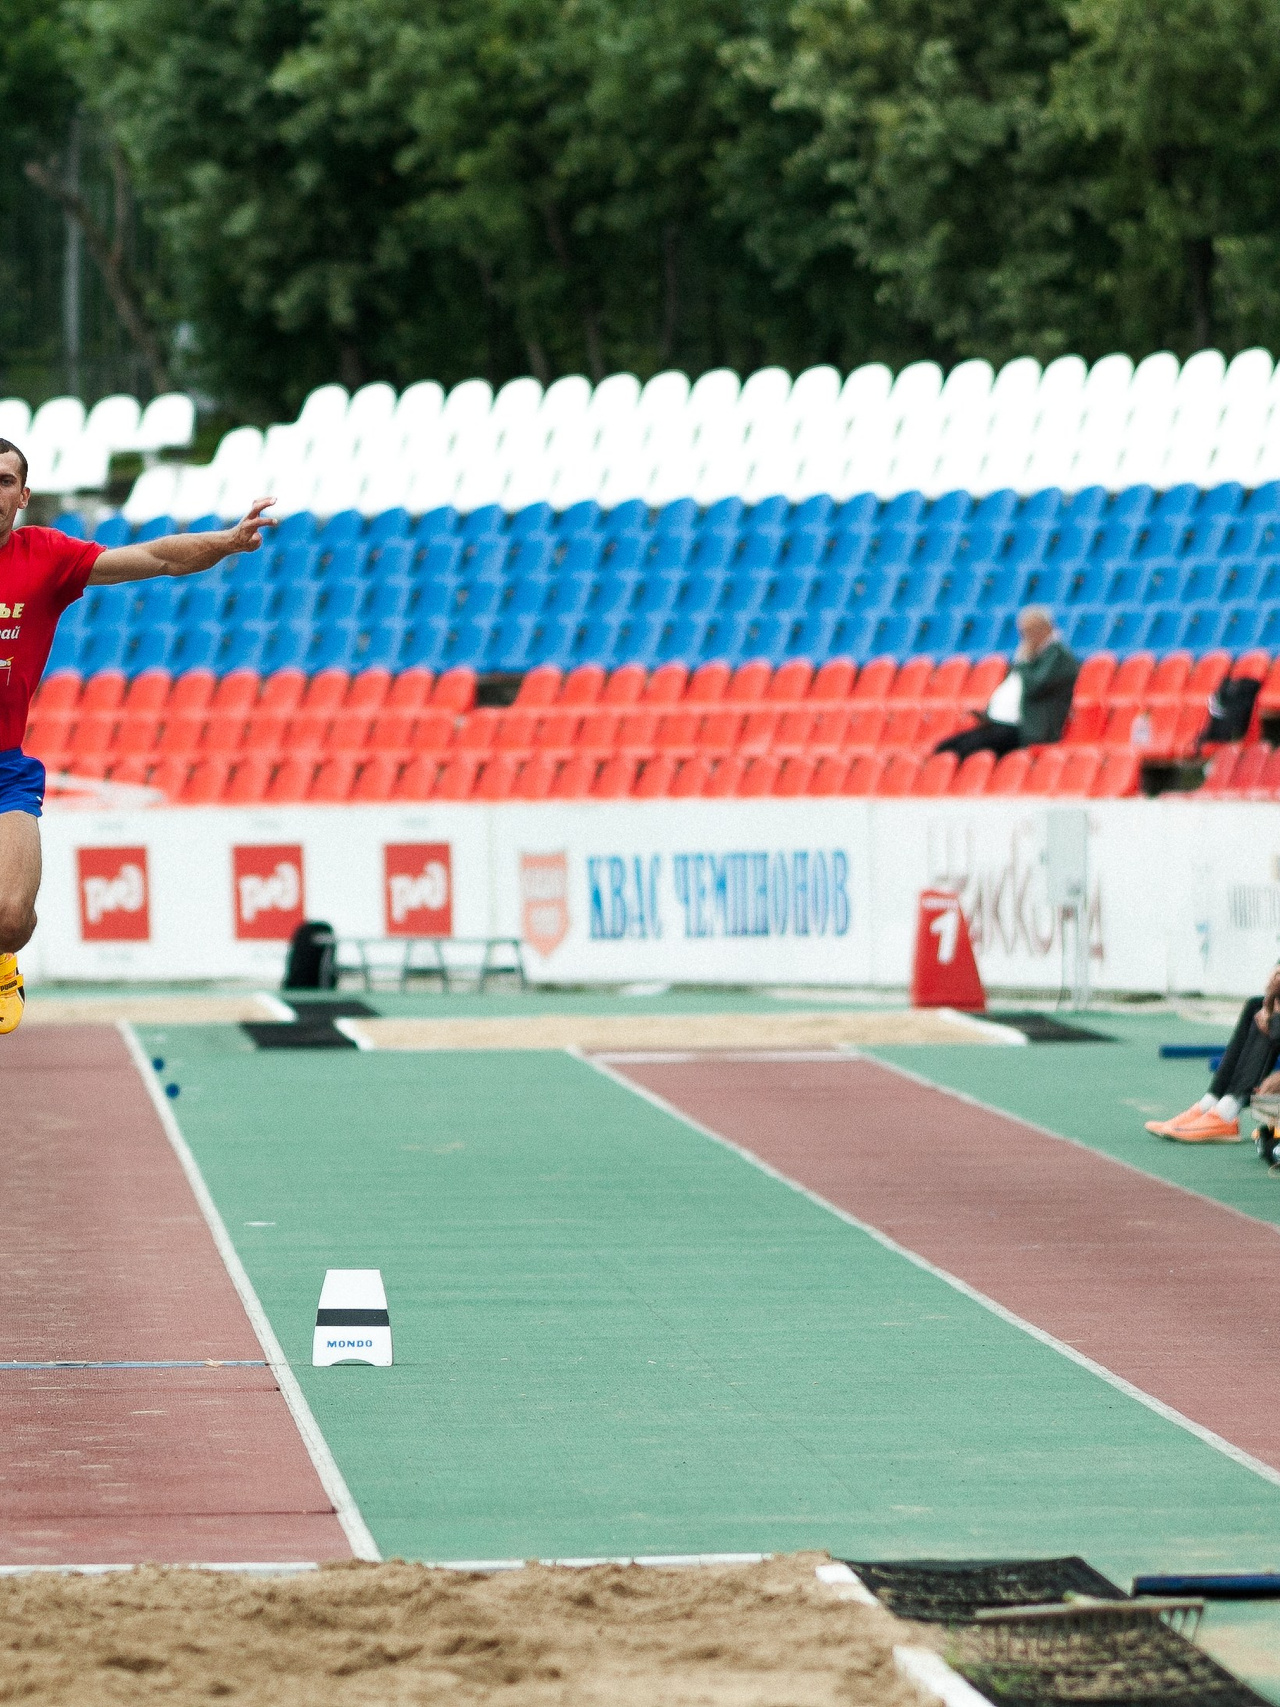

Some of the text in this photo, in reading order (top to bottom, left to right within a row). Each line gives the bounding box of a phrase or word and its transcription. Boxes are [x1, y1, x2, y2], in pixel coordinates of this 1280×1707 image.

[586, 848, 851, 940] КВАС ЧЕМПИОНОВ
[930, 911, 959, 964] 1
[326, 1340, 373, 1348] MONDO
